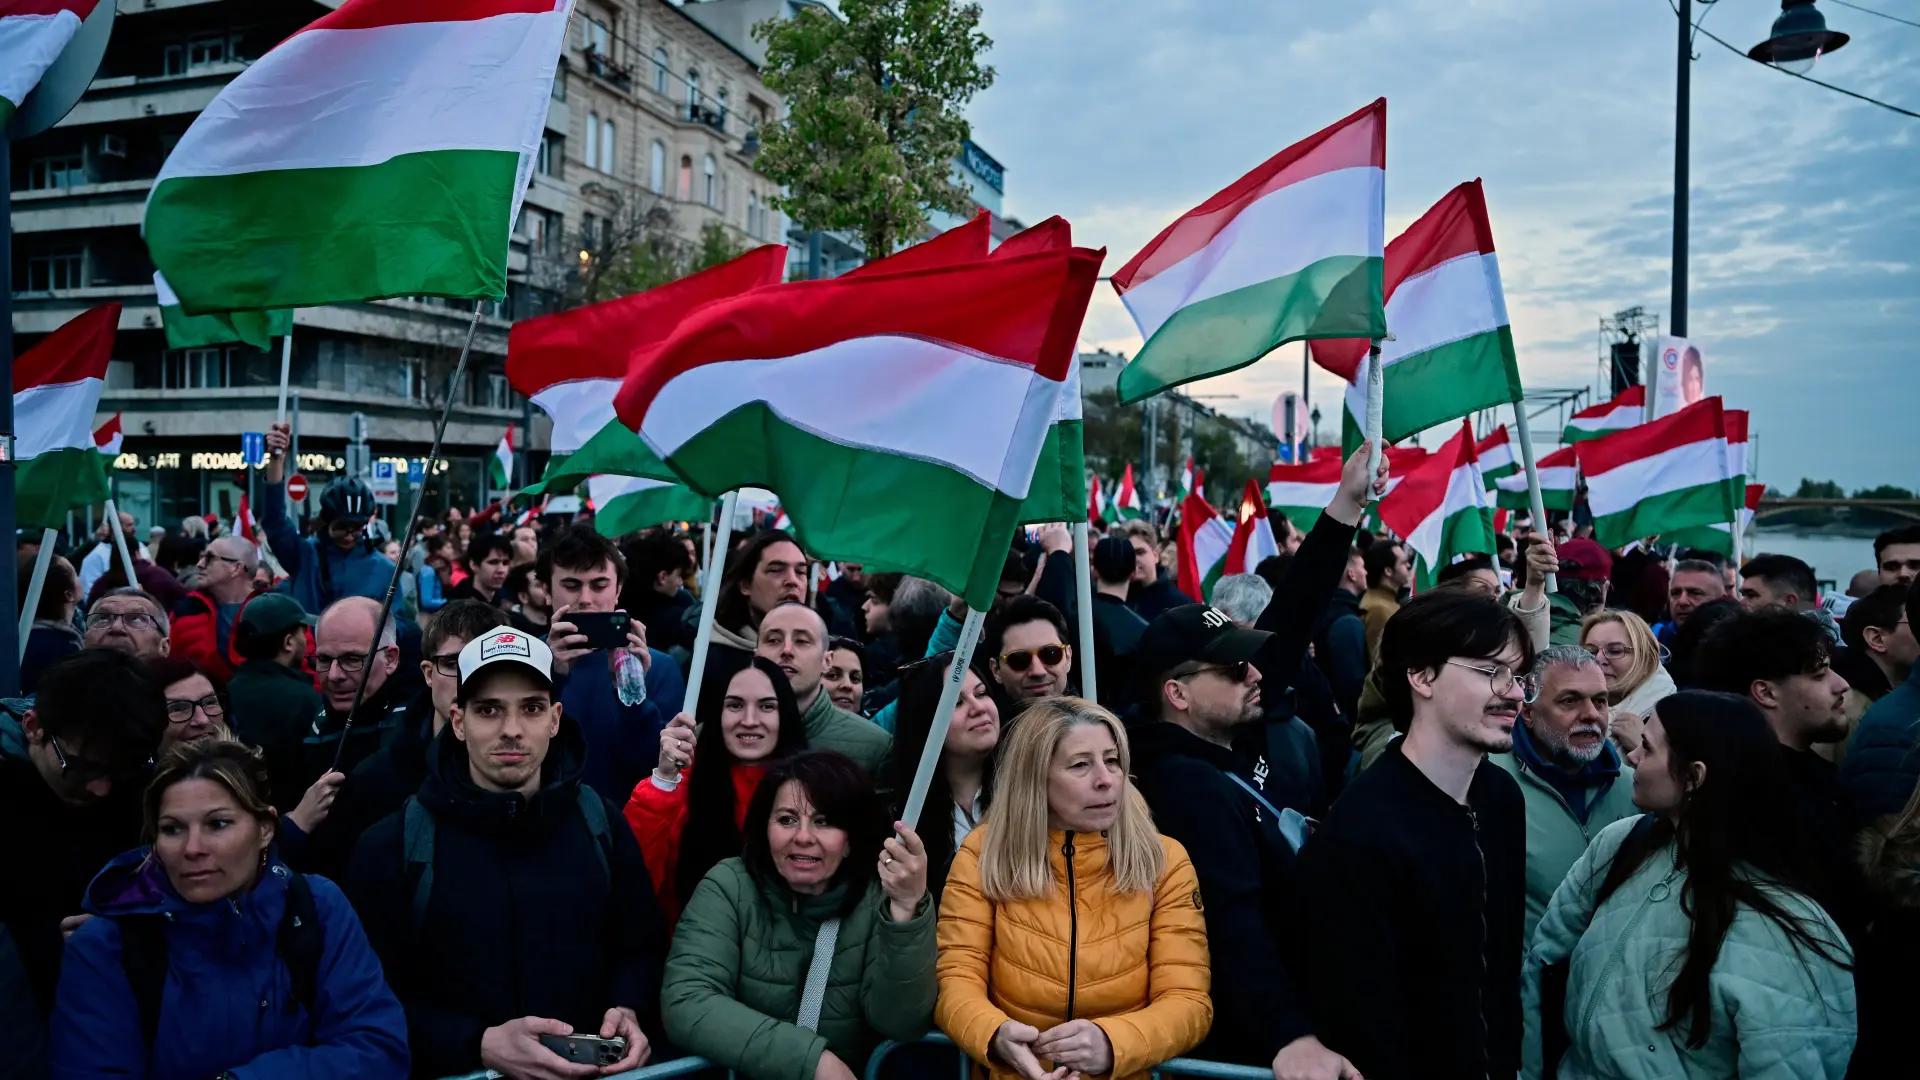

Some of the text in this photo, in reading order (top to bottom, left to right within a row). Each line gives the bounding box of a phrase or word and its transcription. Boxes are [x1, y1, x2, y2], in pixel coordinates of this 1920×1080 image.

[378, 462, 390, 477] P
[483, 643, 527, 654] new balance
